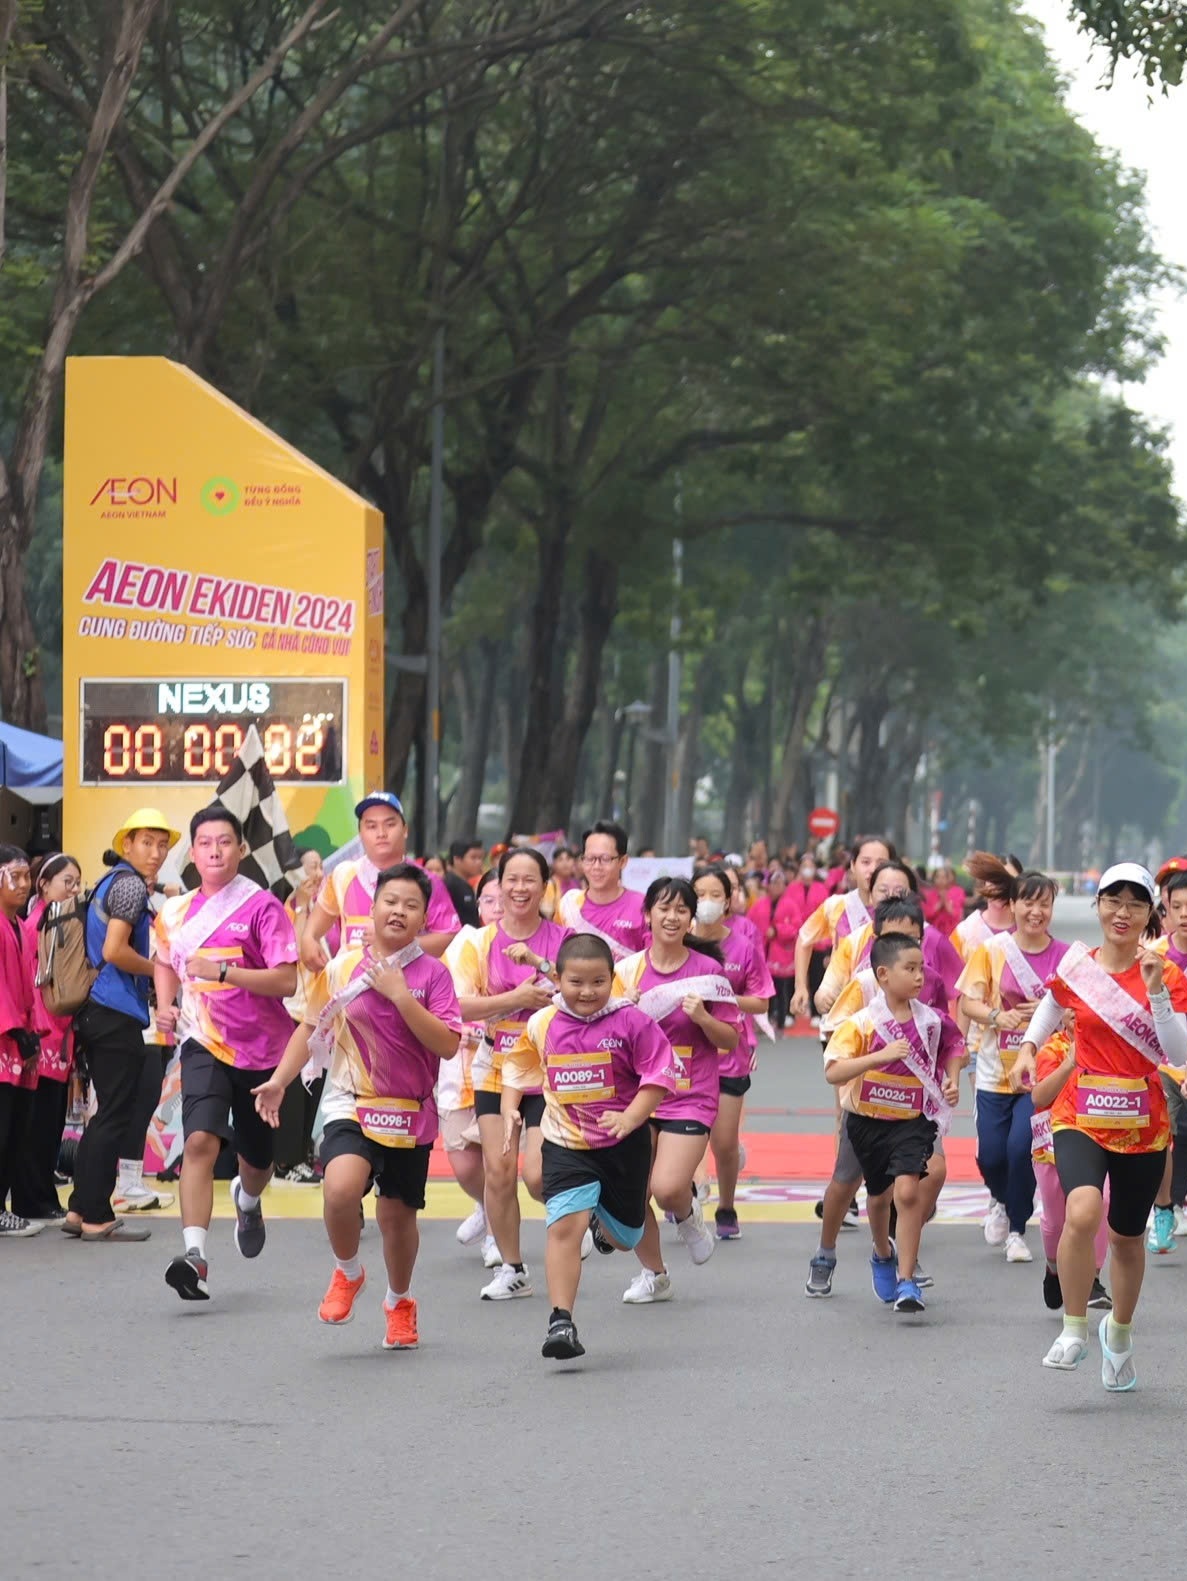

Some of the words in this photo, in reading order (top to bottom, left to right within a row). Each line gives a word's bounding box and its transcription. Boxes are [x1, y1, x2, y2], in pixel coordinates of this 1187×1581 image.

[101, 511, 125, 519] AEON
[126, 510, 167, 519] VIETNAM
[84, 560, 188, 613] AEON
[188, 576, 292, 625] EKIDEN
[293, 594, 353, 633] 2024
[78, 616, 126, 639] CUNG
[226, 626, 257, 649] SỨC
[331, 636, 352, 657] VUI
[157, 682, 270, 714] NEXUS
[103, 724, 162, 775] 00
[554, 1069, 606, 1084] A0089-1
[868, 1086, 917, 1102] A0026-1
[1085, 1093, 1142, 1109] A0022-1
[363, 1112, 413, 1128] A0098-1
